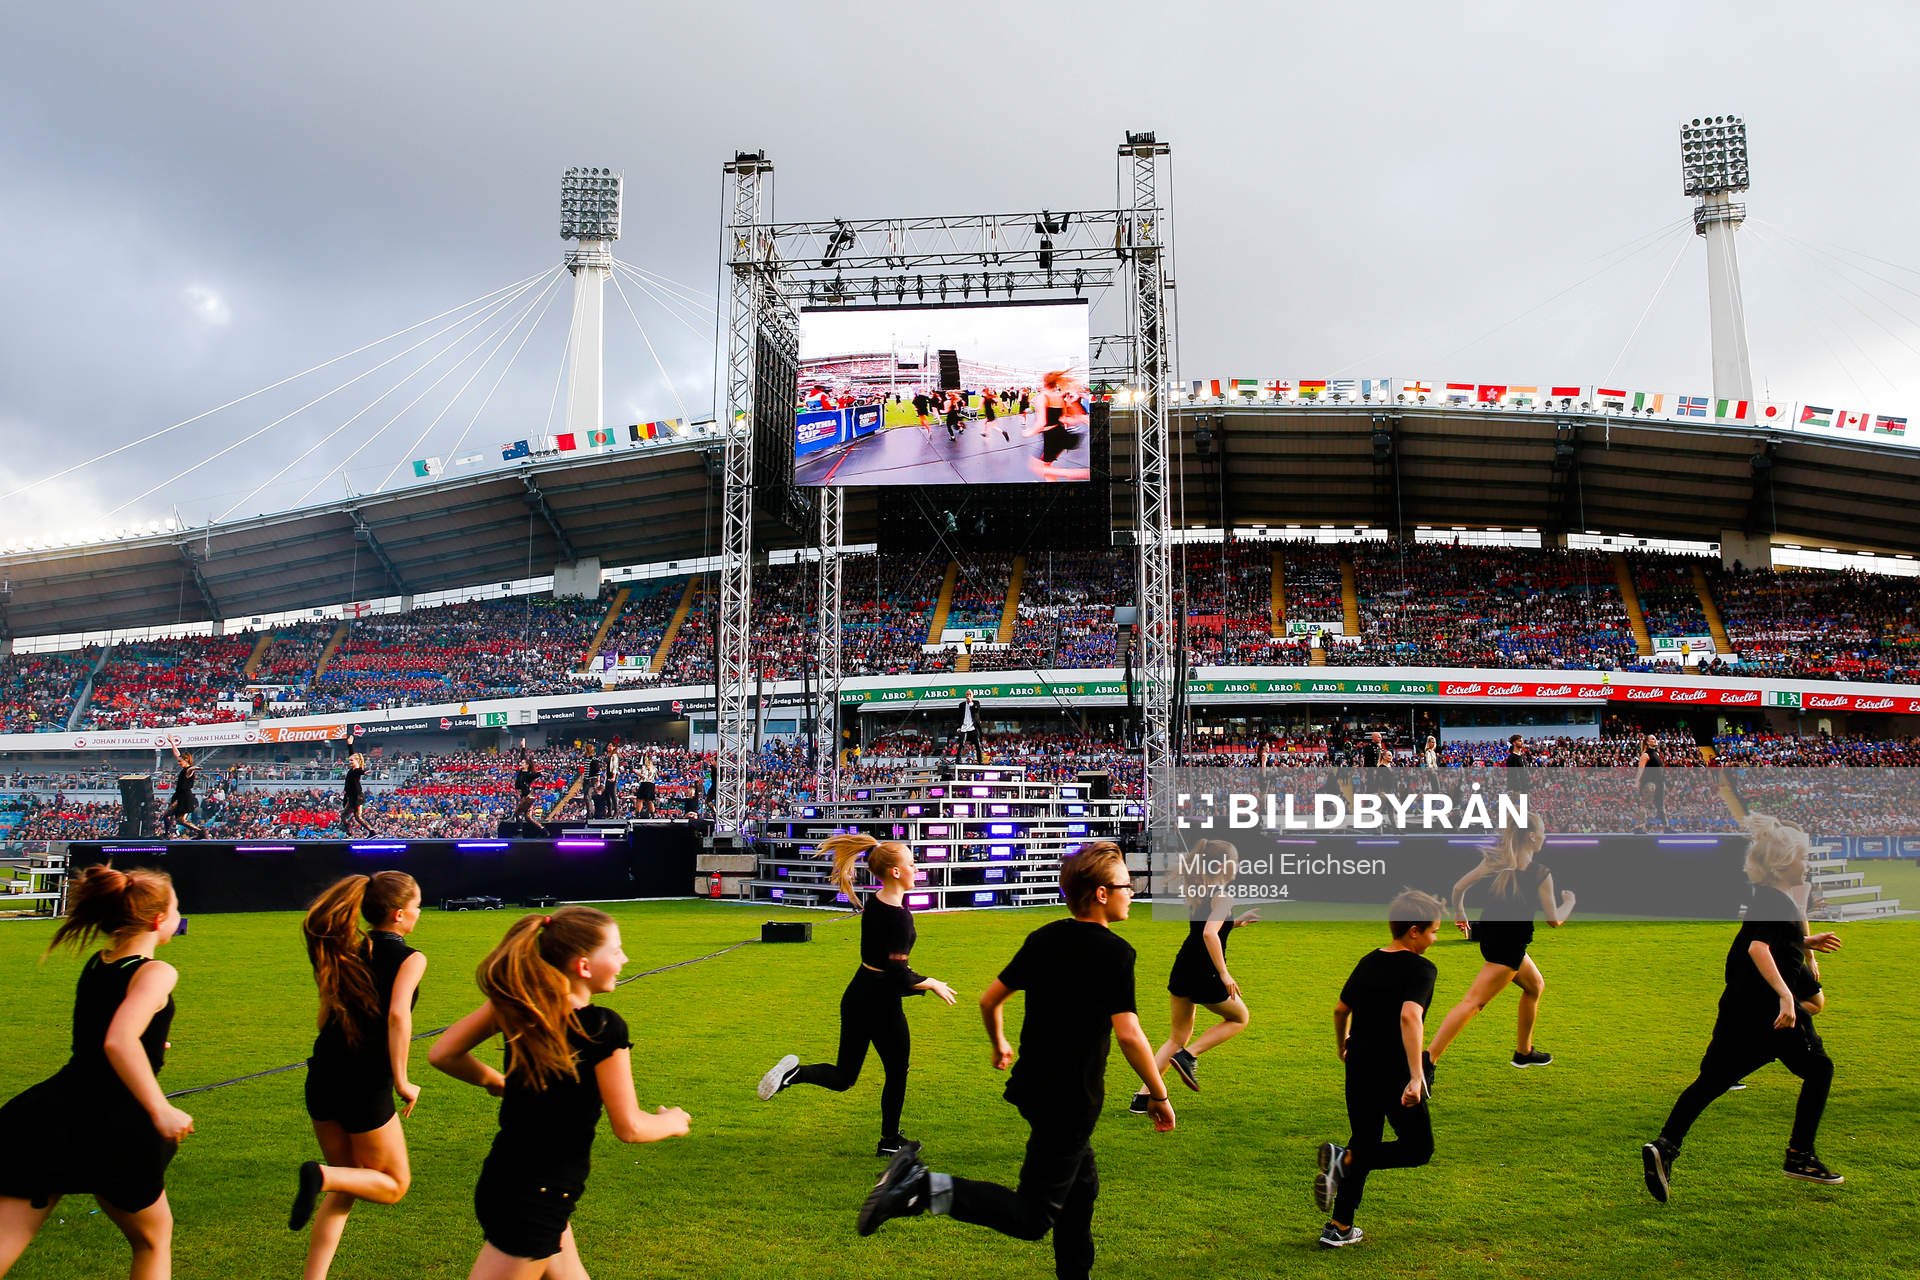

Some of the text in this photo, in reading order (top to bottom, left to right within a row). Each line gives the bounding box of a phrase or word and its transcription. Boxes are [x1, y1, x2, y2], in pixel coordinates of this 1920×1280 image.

[797, 419, 837, 432] GOTHIA
[797, 429, 821, 440] CUP
[973, 687, 992, 696] BRO
[1445, 683, 1758, 703] Estrella Estrella Estrella Estrella Estrella Estrella Estrella
[1809, 695, 1849, 707] Estrella
[1854, 698, 1895, 710] Estrella
[551, 711, 575, 719] veckan!
[601, 708, 623, 716] Lördag
[636, 705, 660, 713] veckan!
[367, 725, 390, 733] Lördag
[404, 722, 428, 730] veckan!
[278, 728, 329, 742] Renova
